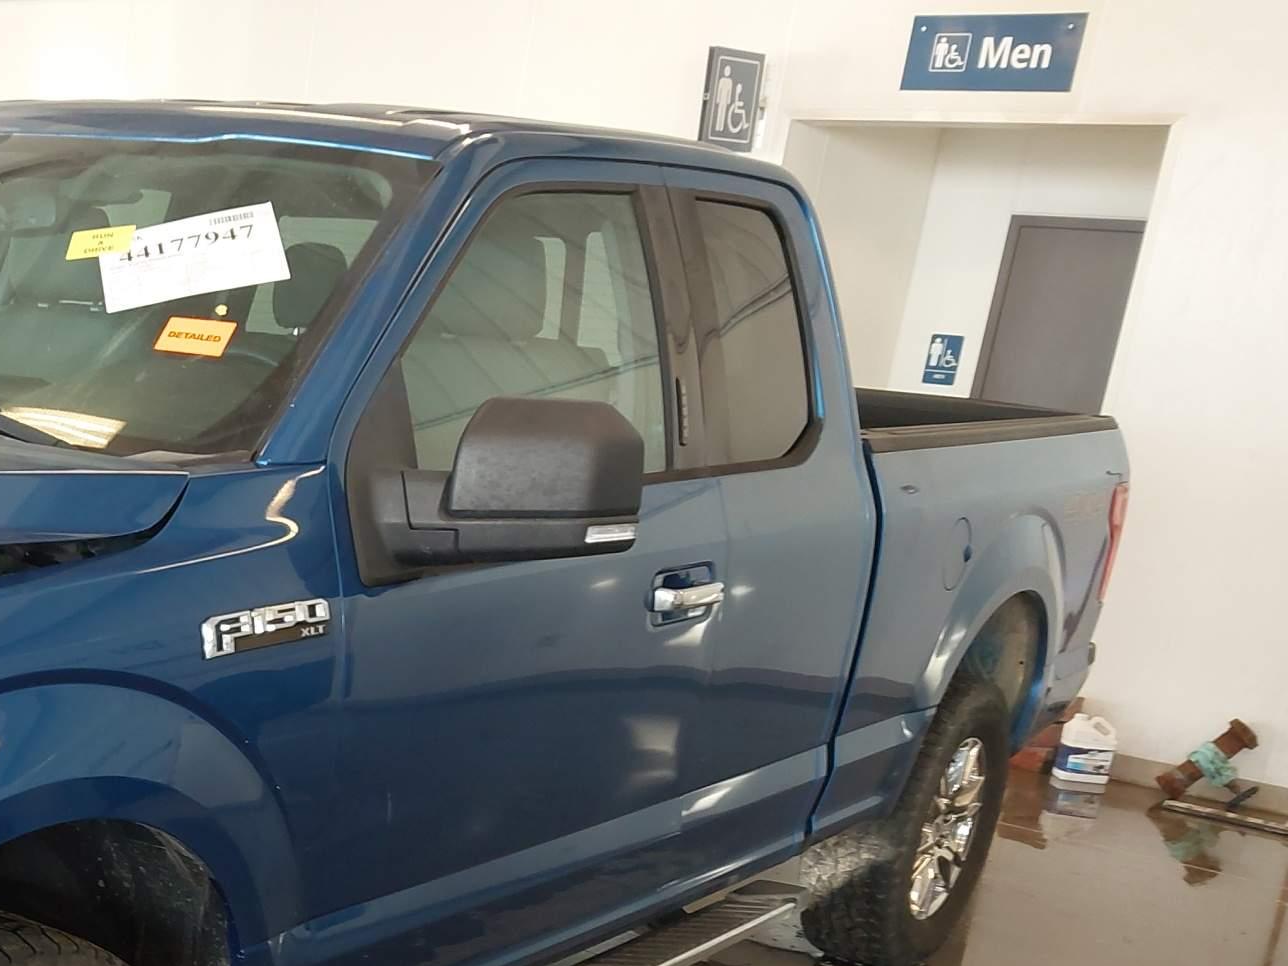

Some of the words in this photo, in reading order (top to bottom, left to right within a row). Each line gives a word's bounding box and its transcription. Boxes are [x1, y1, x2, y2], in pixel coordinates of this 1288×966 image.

[977, 36, 1052, 69] Men
[119, 224, 255, 262] 44177947
[167, 331, 222, 342] DETAILED
[301, 624, 326, 638] XLT
